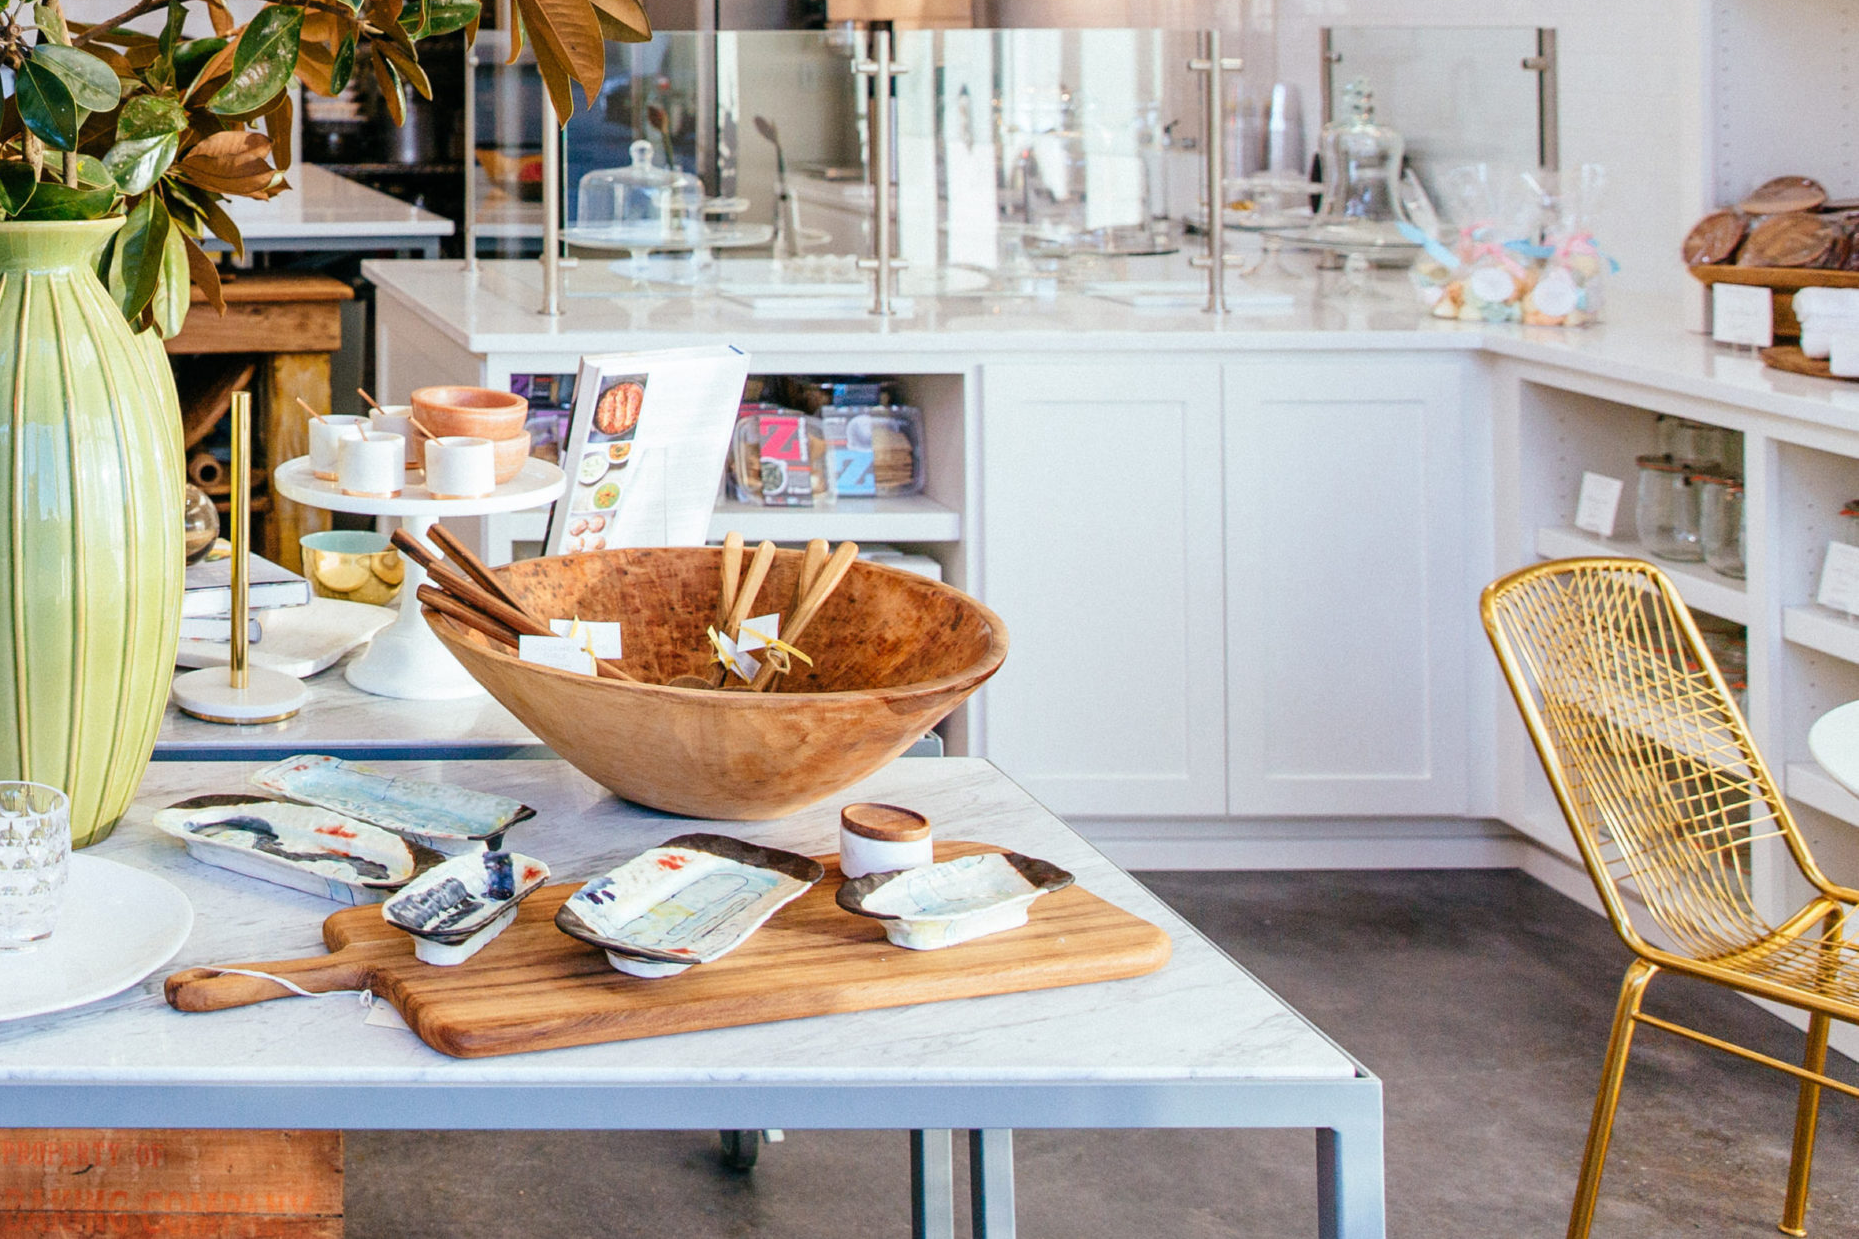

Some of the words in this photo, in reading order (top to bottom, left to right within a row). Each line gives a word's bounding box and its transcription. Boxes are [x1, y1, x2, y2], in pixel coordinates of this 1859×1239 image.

[760, 417, 802, 460] Z
[1, 1140, 121, 1166] PROPERTY
[135, 1143, 165, 1167] OF
